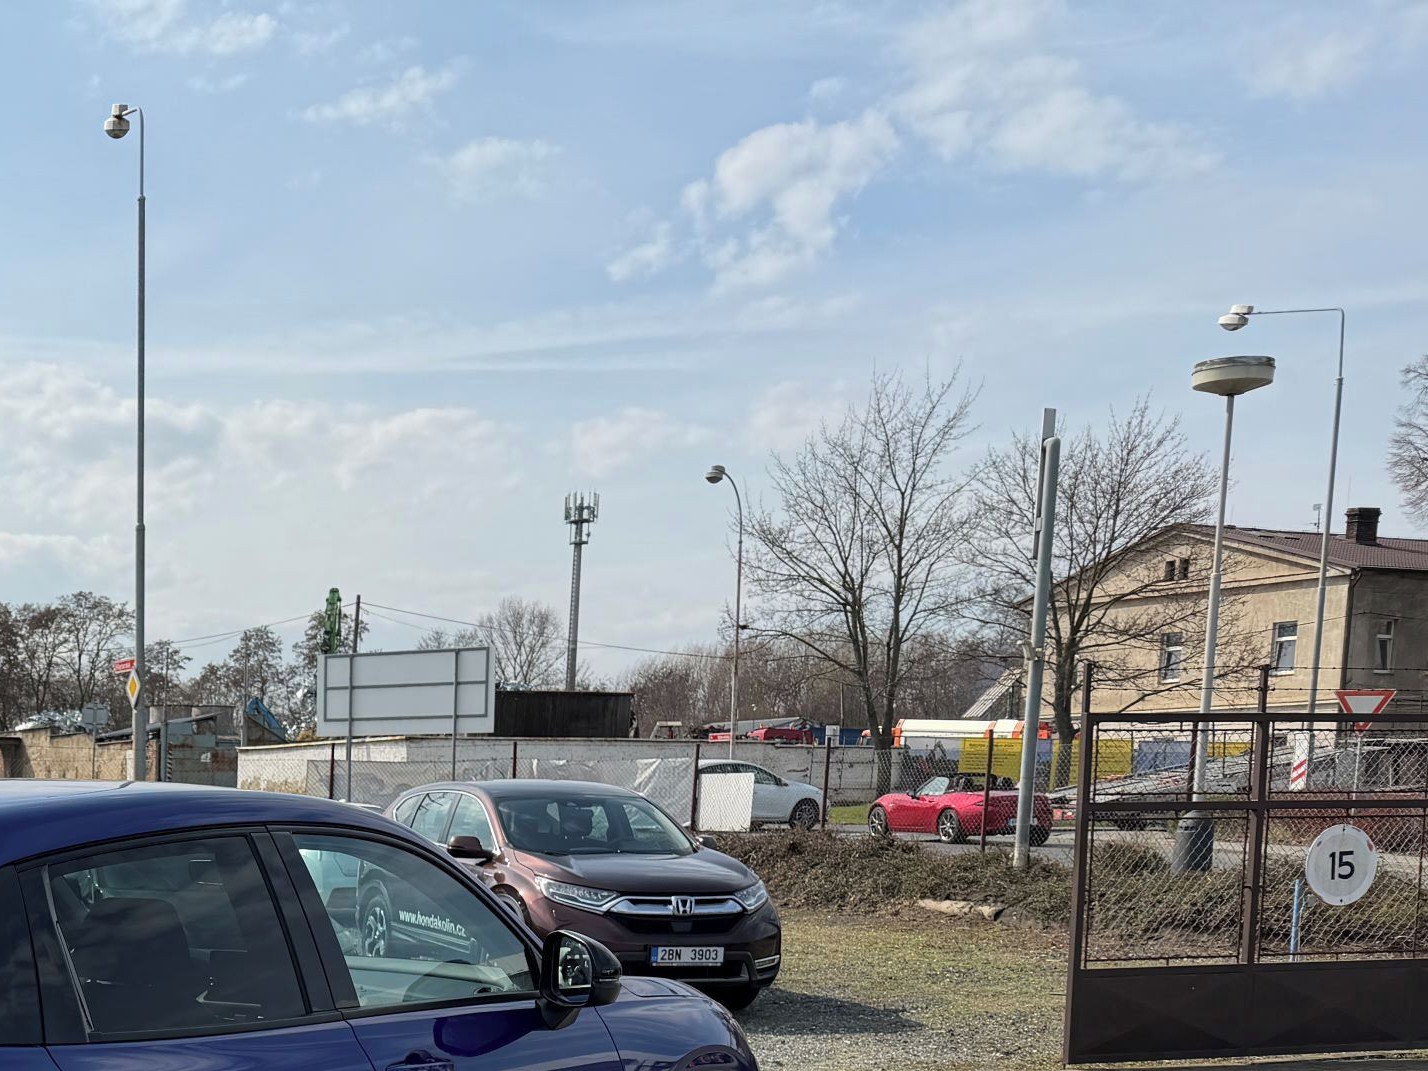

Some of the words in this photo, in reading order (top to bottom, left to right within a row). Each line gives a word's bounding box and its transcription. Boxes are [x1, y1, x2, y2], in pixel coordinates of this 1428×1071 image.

[1329, 850, 1355, 880] 15
[398, 910, 467, 937] www.hondakolin.cz
[660, 948, 682, 961] 2BN
[690, 948, 719, 961] 3903
